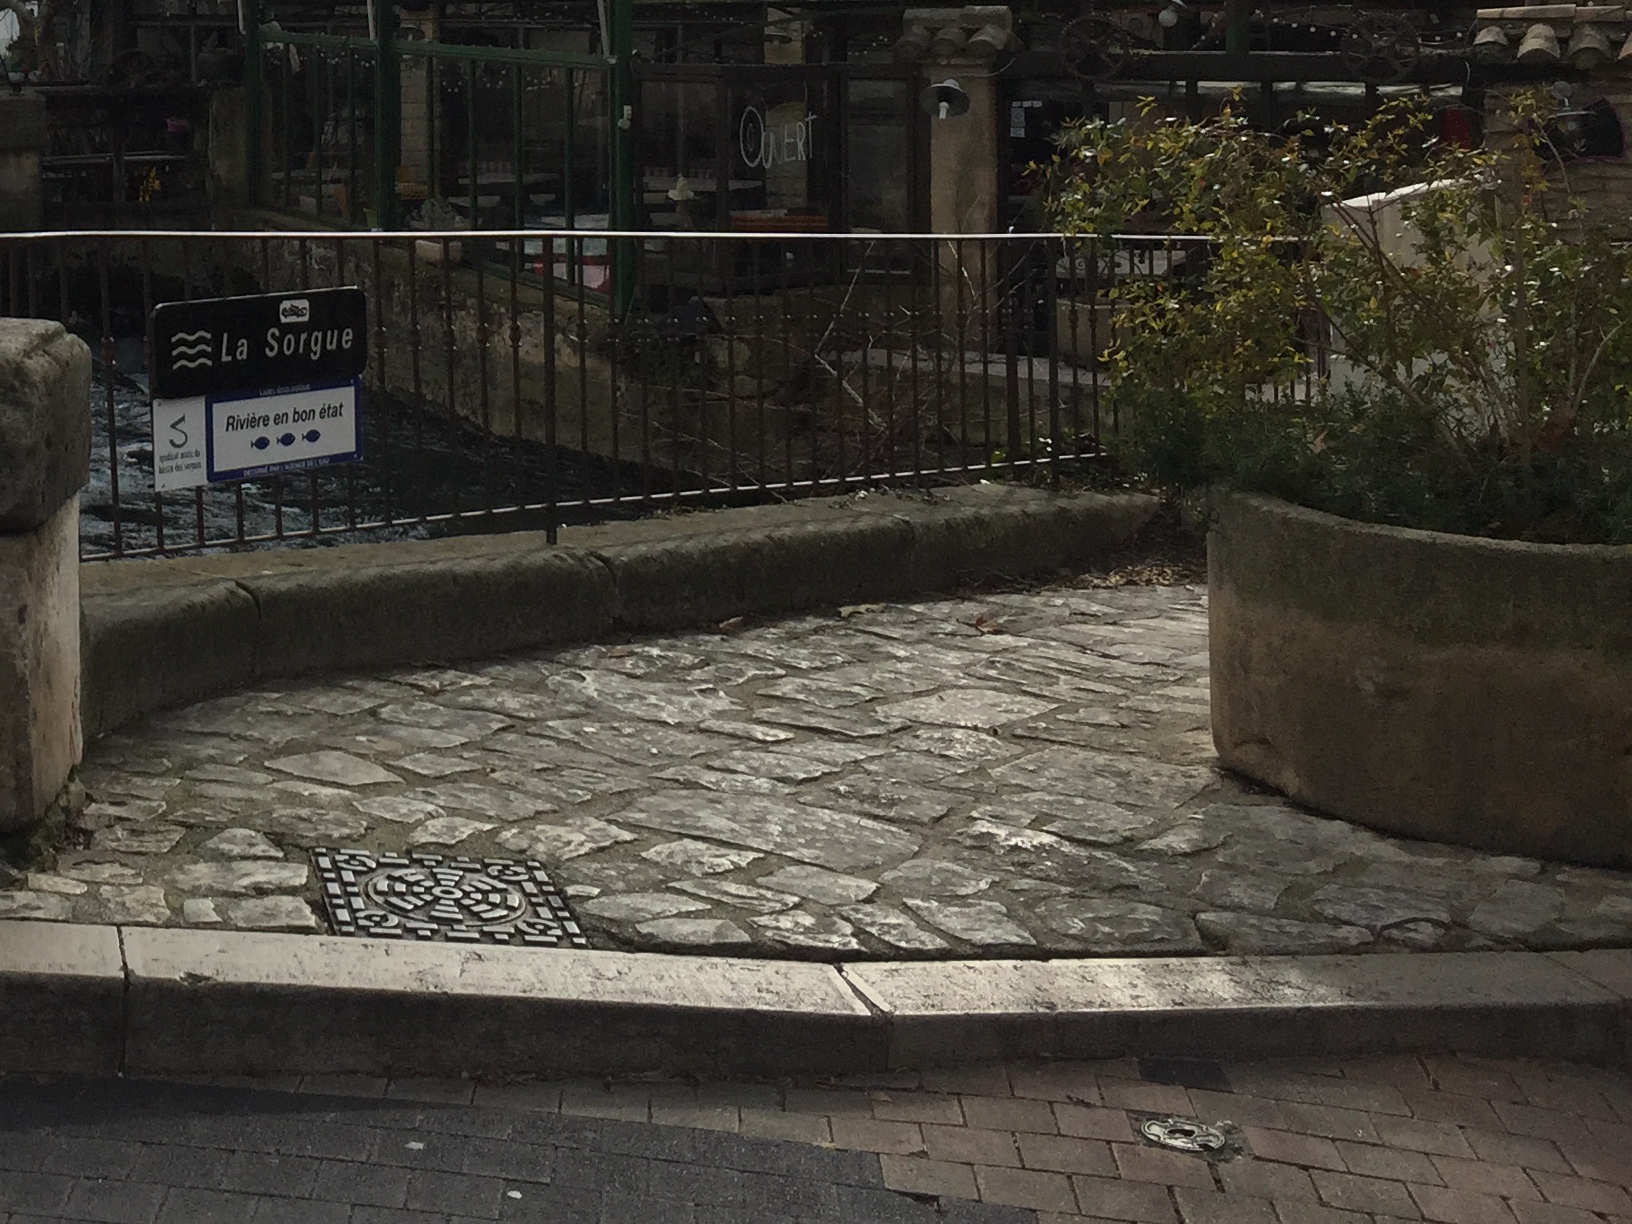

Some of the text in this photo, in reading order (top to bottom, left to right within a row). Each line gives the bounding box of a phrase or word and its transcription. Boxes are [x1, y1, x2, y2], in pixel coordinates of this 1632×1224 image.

[221, 326, 354, 362] La Sorgue
[225, 401, 344, 432] Rivière en bon état
